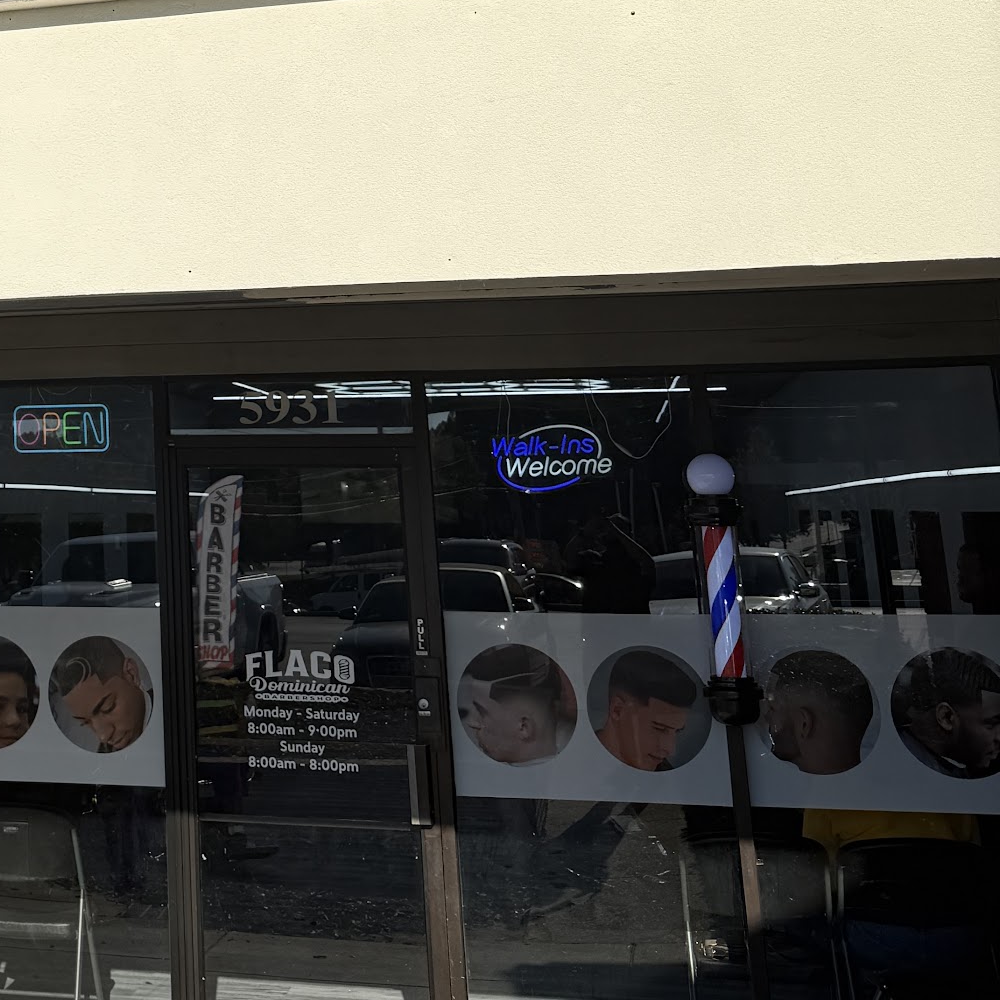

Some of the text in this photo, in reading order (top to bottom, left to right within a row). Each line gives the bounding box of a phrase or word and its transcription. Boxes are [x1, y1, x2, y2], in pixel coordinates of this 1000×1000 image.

[238, 388, 345, 425] 5931
[17, 411, 105, 446] OPEN
[491, 434, 595, 458] Walk-Ins
[506, 455, 613, 478] Welcome
[203, 503, 226, 642] BARBER
[416, 618, 426, 650] PULL
[245, 649, 355, 685] FLACO
[249, 676, 351, 694] Dominican
[264, 694, 340, 702] BARBERSHOP
[243, 705, 293, 721] Monday
[305, 708, 360, 723] Saturday
[247, 722, 296, 736] 8:00am
[279, 740, 325, 756] Sunday
[248, 756, 297, 770] 8:00am
[309, 759, 360, 774] 8:00pm
